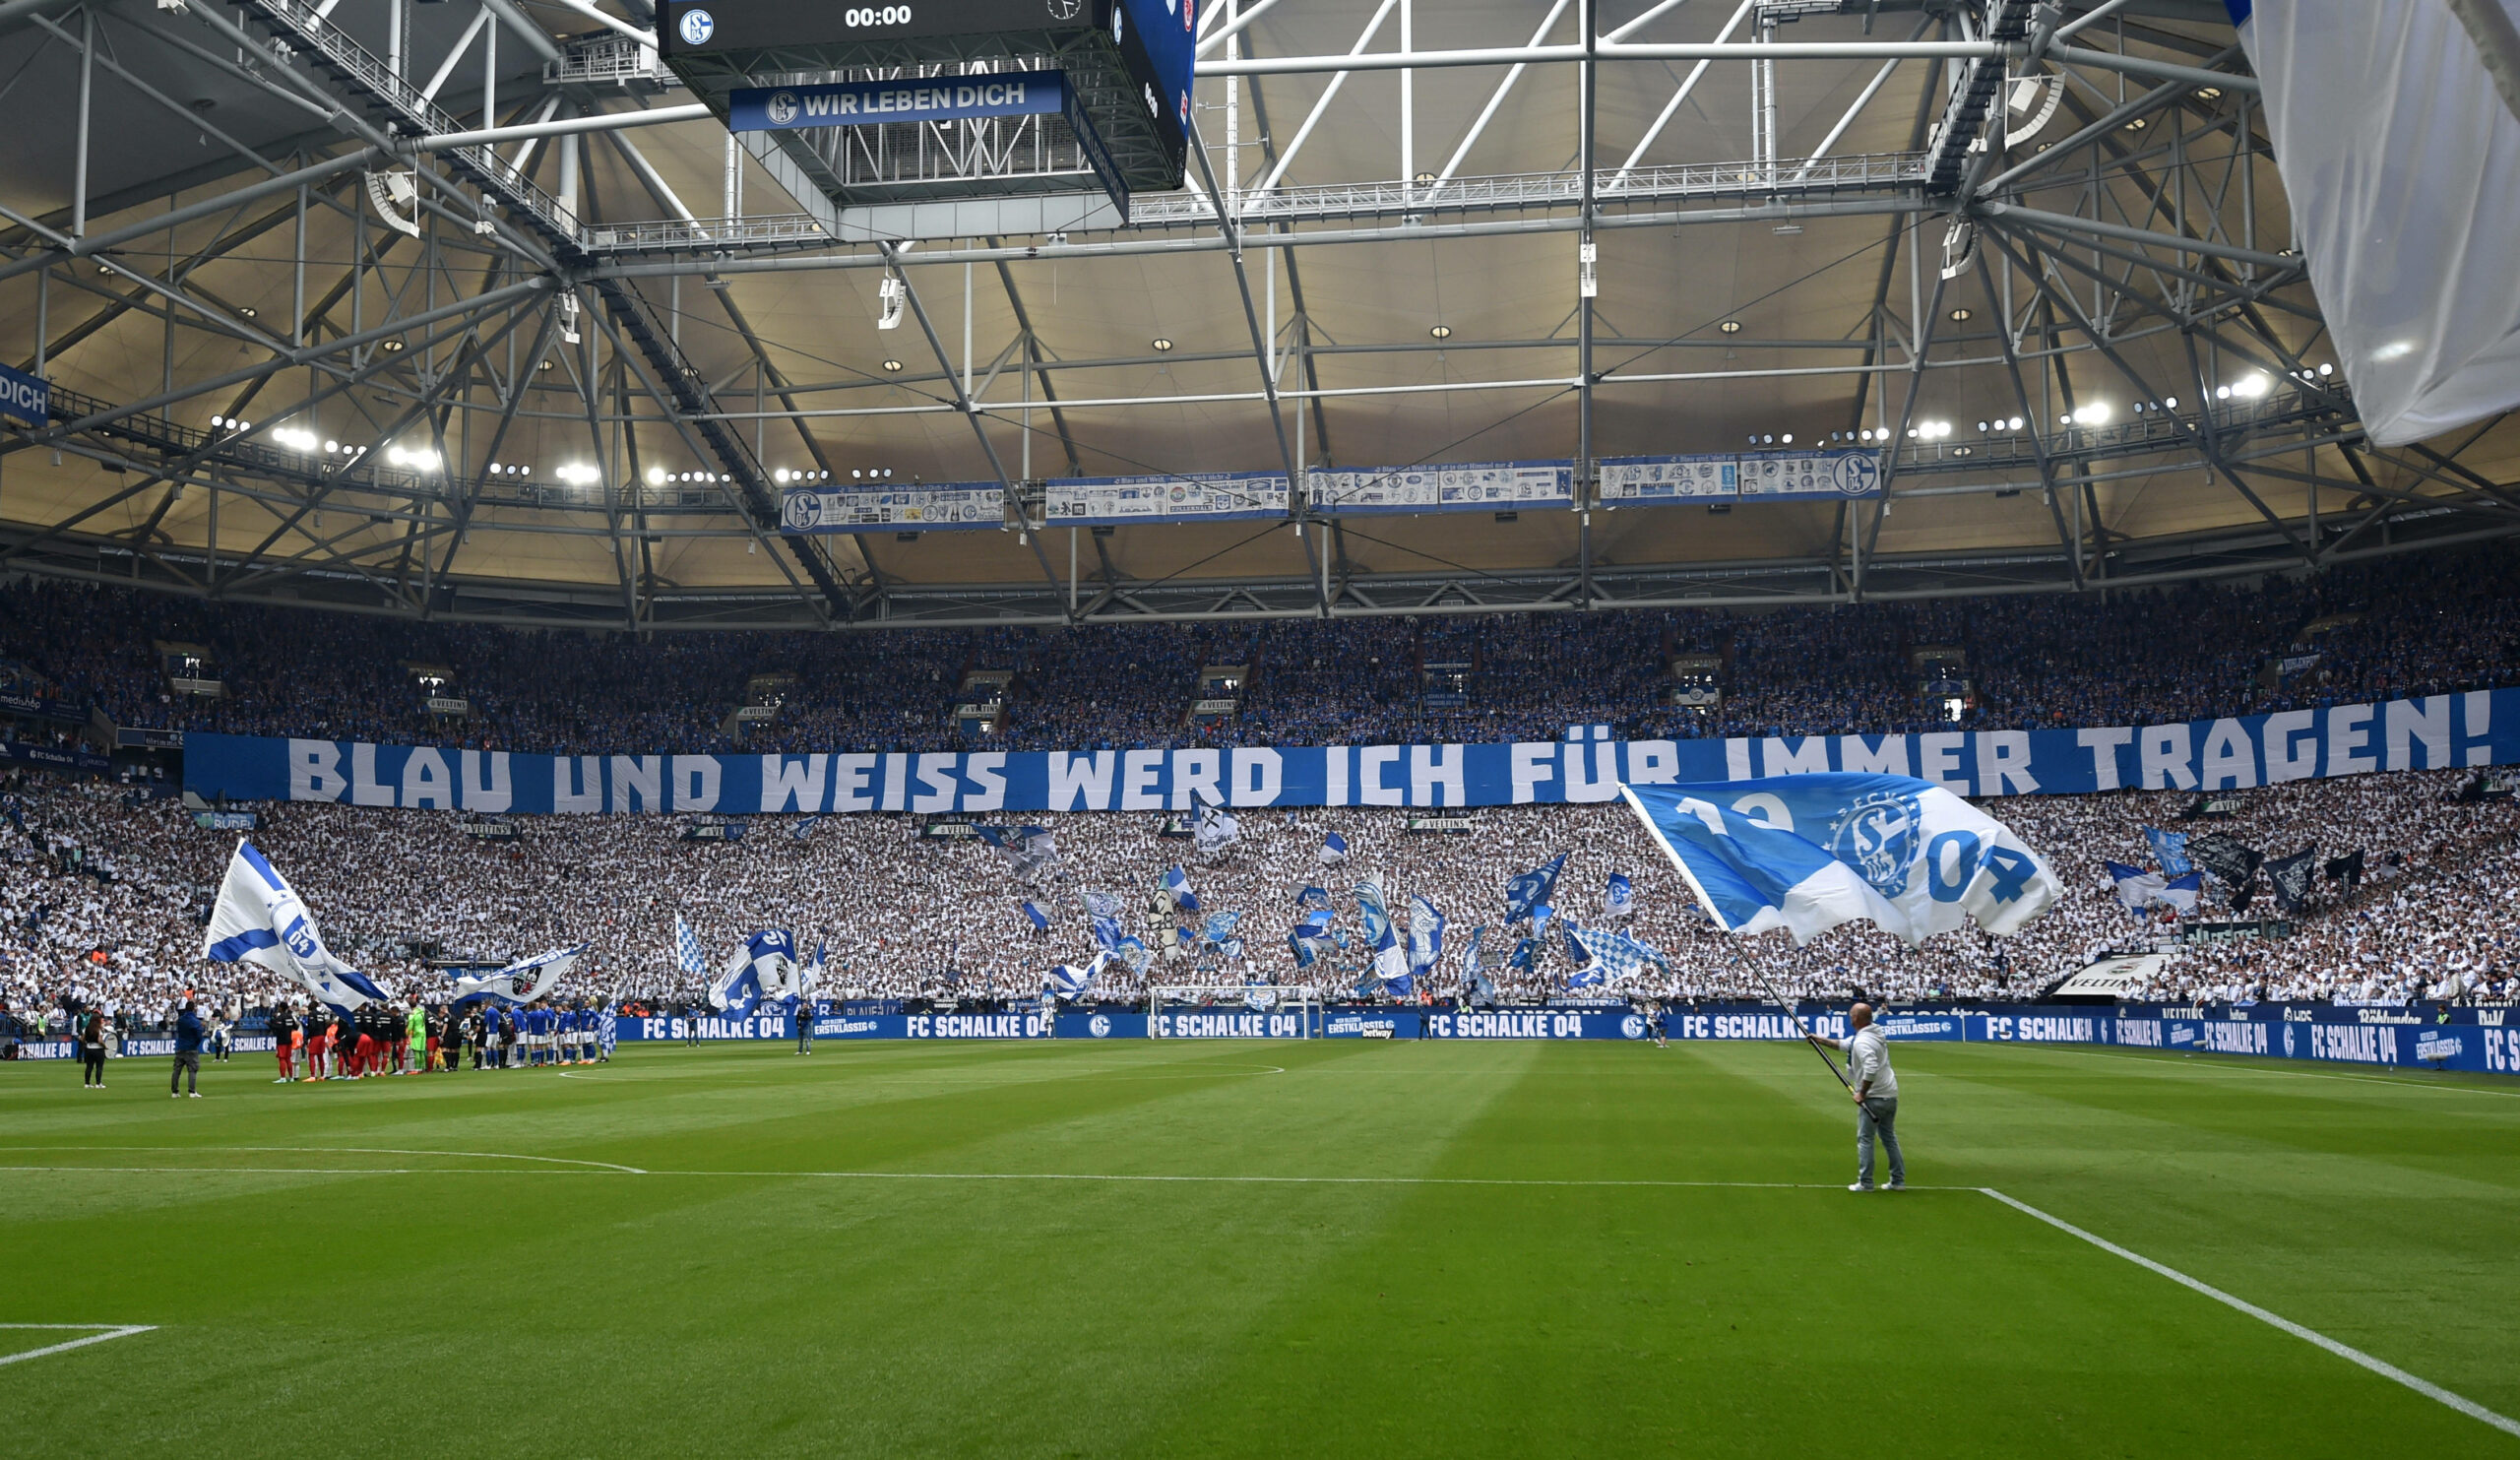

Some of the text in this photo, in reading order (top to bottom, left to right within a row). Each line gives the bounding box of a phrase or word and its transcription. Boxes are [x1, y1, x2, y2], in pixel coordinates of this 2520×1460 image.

[846, 5, 912, 28] 00:00
[803, 83, 1025, 116] WIR LEBEN DICH
[0, 375, 45, 414] DICH
[288, 689, 2491, 814] BLAU UND WEISS WERD ICH FÜR IMMER TRAGEN!
[472, 824, 507, 835] VELTINS
[947, 825, 977, 834] VELTIN
[1429, 819, 1465, 828] VELTINS
[1926, 830, 2038, 905] 04
[288, 930, 309, 954] 04
[2070, 979, 2128, 987] VELTIN
[643, 1018, 665, 1040] FC
[759, 1017, 785, 1038] 04
[814, 1021, 868, 1035] ERSTKLASSIG
[907, 1016, 930, 1038] FC
[935, 1016, 1021, 1038] SCHALKE
[1176, 1015, 1264, 1037] SCHALKE
[1270, 1015, 1296, 1037] 04
[1362, 1028, 1392, 1040] betway
[1429, 1015, 1582, 1038] FC SCHALKE 04
[1683, 1016, 1845, 1039] FC SCHALKE 04
[1985, 1017, 2013, 1040] FC
[2018, 1017, 2084, 1042] SCHALKE
[2115, 1019, 2162, 1047] FC SCHALKE 04
[59, 1042, 72, 1057] 04
[127, 1039, 176, 1055] FC SCHALKE
[234, 1037, 266, 1051] SCHALKE
[267, 1036, 277, 1050] 04
[2204, 1022, 2268, 1054] FC SCHALKE 04
[2311, 1025, 2398, 1063] FC SCHALKE 04
[2484, 1029, 2506, 1071] FC
